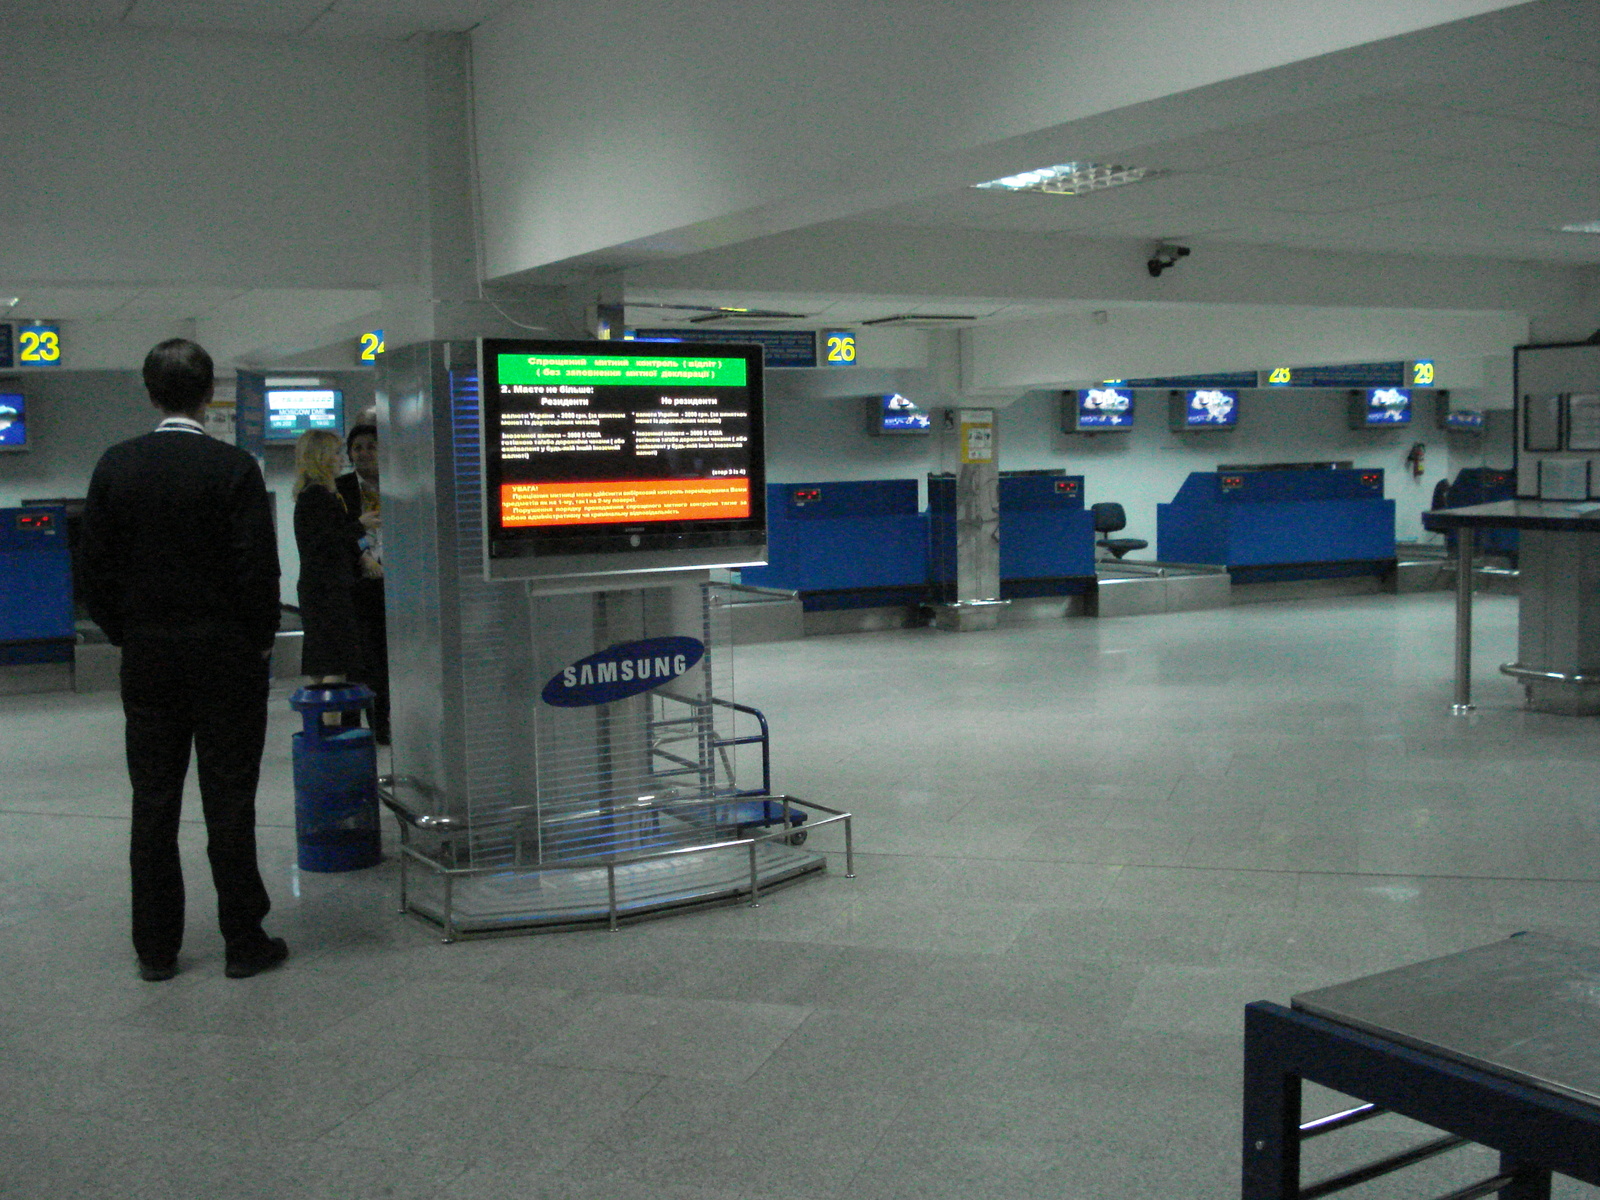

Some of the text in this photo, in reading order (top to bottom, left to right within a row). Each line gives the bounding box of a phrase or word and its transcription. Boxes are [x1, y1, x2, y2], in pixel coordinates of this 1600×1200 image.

[20, 332, 60, 361] 23
[828, 337, 855, 361] 26
[528, 357, 587, 366] Спрощений
[636, 360, 679, 368] контроль
[1269, 368, 1291, 383] 28
[1413, 363, 1434, 384] 29
[501, 385, 511, 393] 2.
[513, 385, 544, 393] Маєте
[560, 385, 594, 394] більше:
[541, 397, 589, 407] Резиденти
[661, 397, 718, 406] Не резиденти
[563, 654, 687, 688] SAMSUNG
